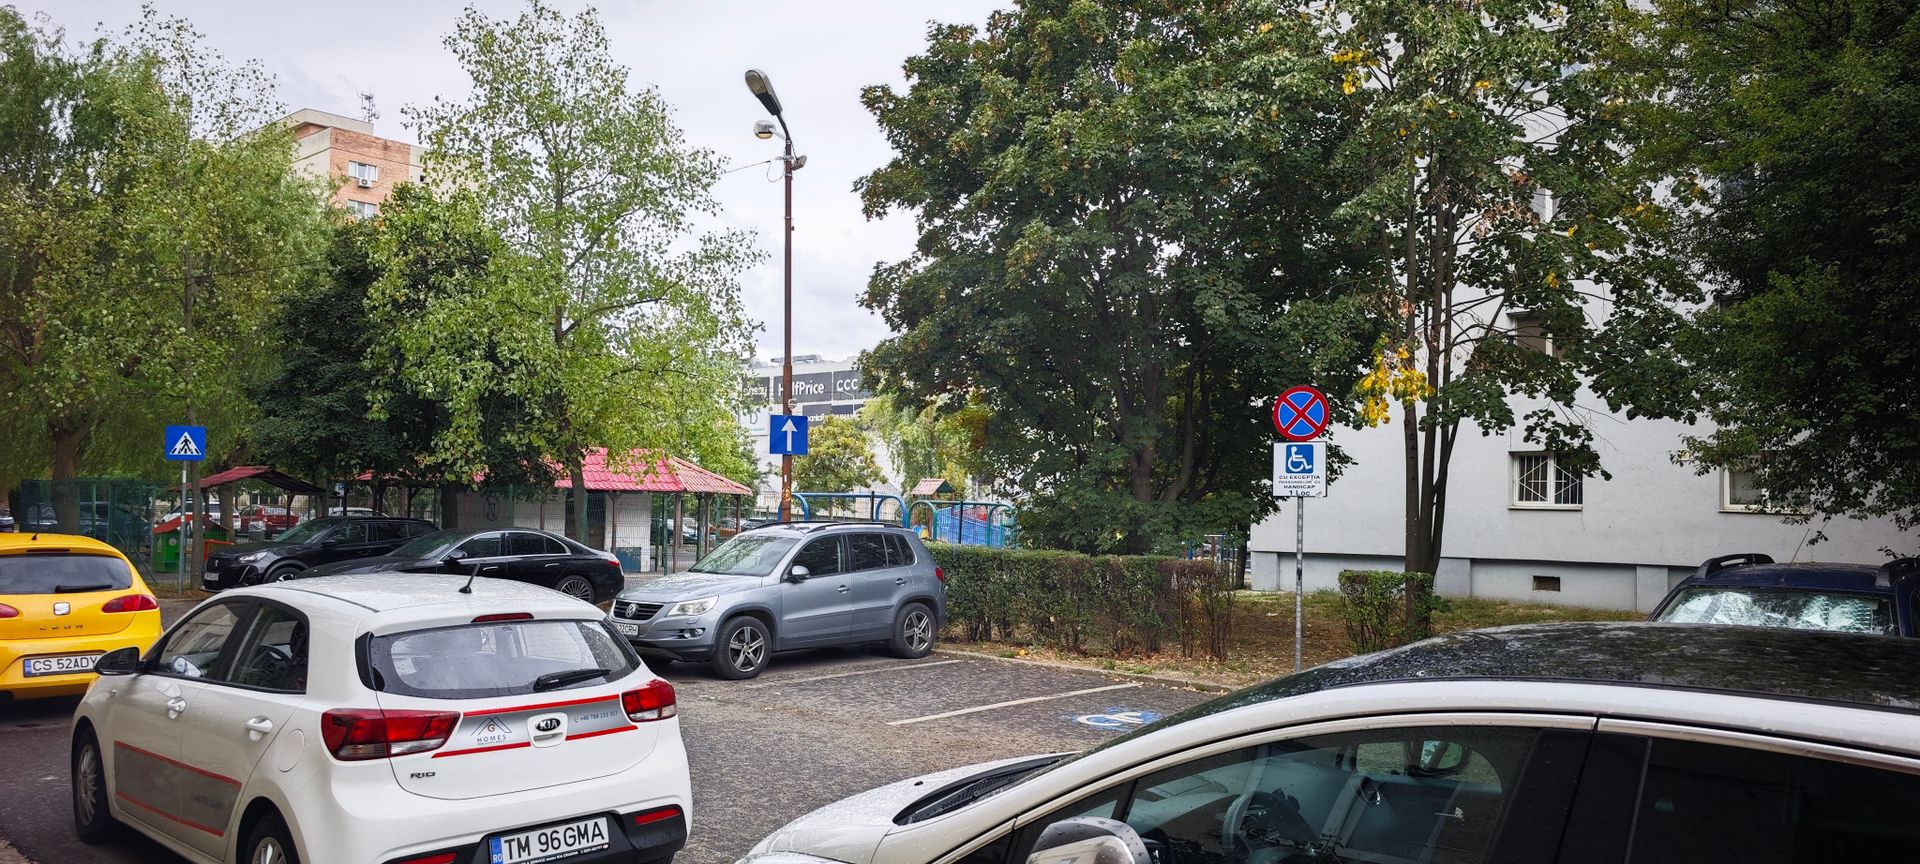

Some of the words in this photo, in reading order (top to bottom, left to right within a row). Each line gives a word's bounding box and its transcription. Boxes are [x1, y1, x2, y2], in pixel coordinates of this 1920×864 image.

[778, 380, 825, 397] HlfPrice
[33, 659, 53, 672] CS
[487, 723, 496, 732] G
[540, 719, 559, 730] KIA
[477, 734, 507, 743] HOMES
[410, 771, 436, 779] RIO
[504, 835, 532, 860] TM
[537, 821, 606, 853] 96GMA
